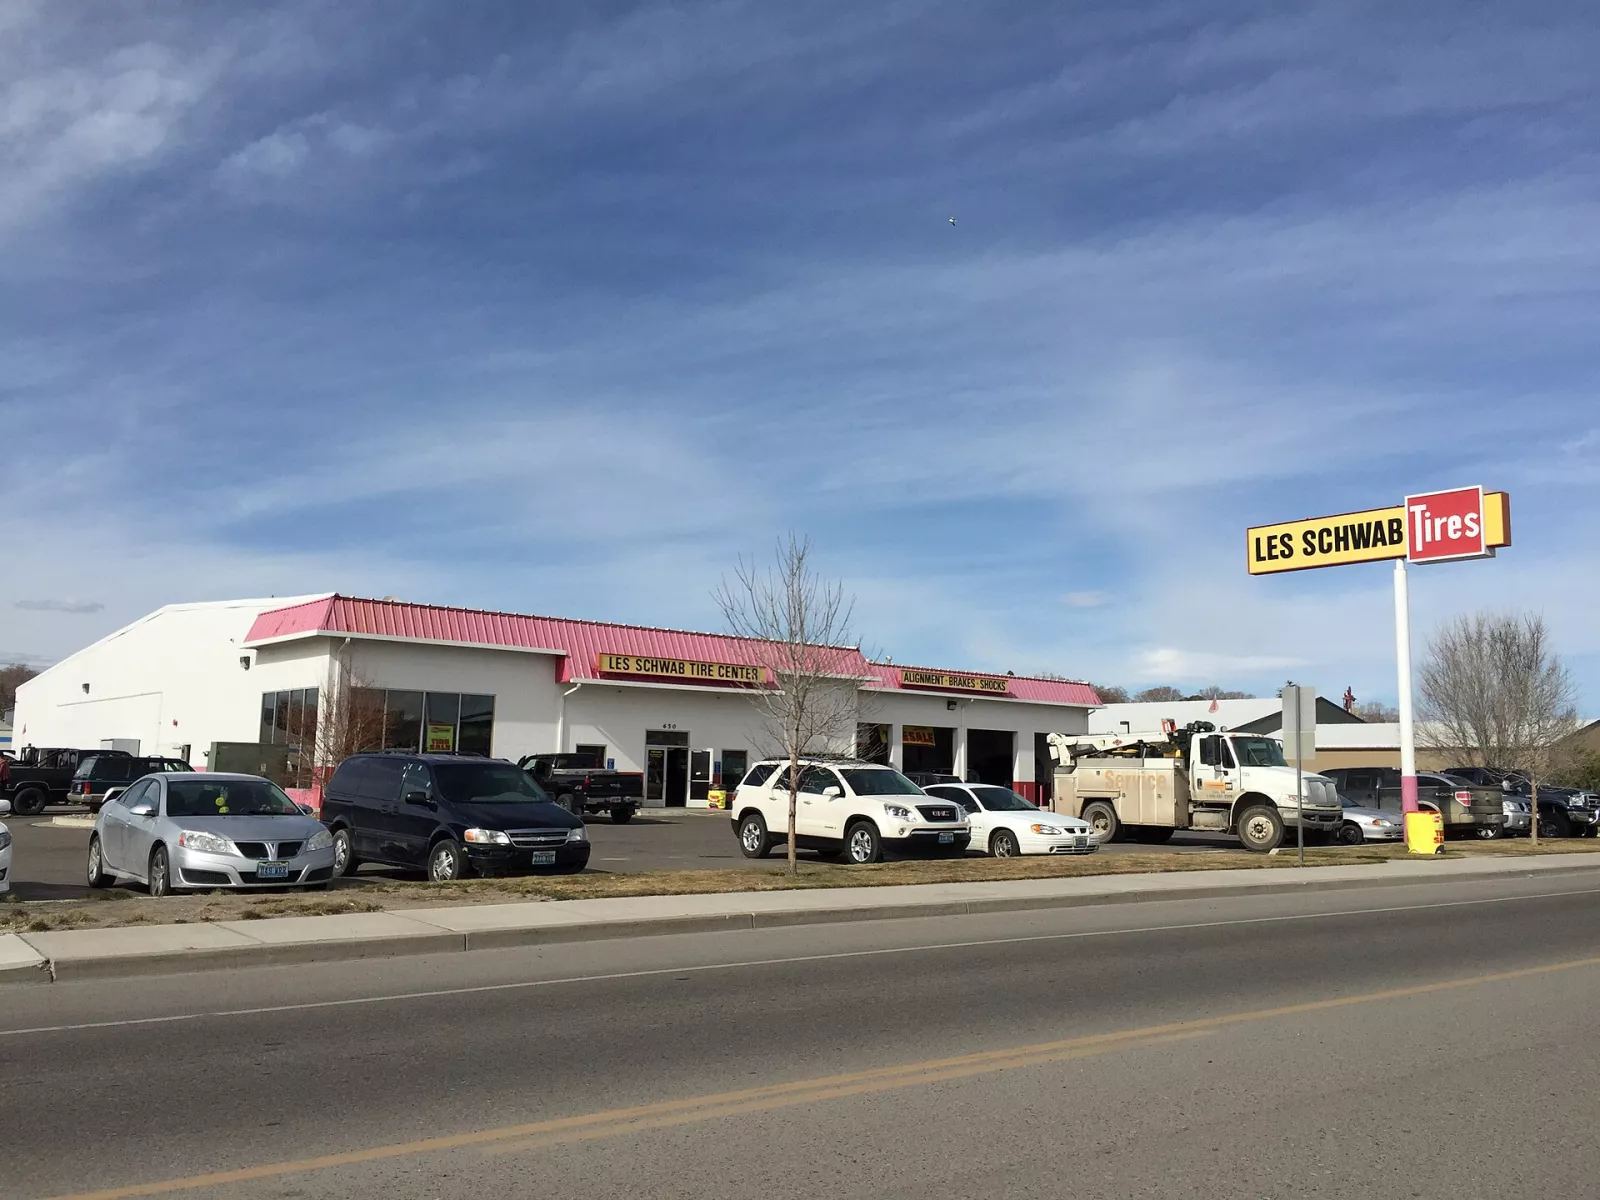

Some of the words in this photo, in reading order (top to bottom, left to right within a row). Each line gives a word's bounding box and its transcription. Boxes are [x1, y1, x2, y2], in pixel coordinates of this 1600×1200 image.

[1255, 533, 1294, 562] LES
[1302, 518, 1404, 556] SCHWAB
[1409, 504, 1480, 552] Tires
[608, 656, 630, 671] LES
[635, 658, 685, 675] SCHWAB
[689, 663, 714, 677] TIRE
[718, 667, 758, 681] CENTER
[903, 672, 945, 686] ALIGNMENT
[948, 676, 976, 689] BRAKES
[979, 679, 1006, 692] SHOCKS
